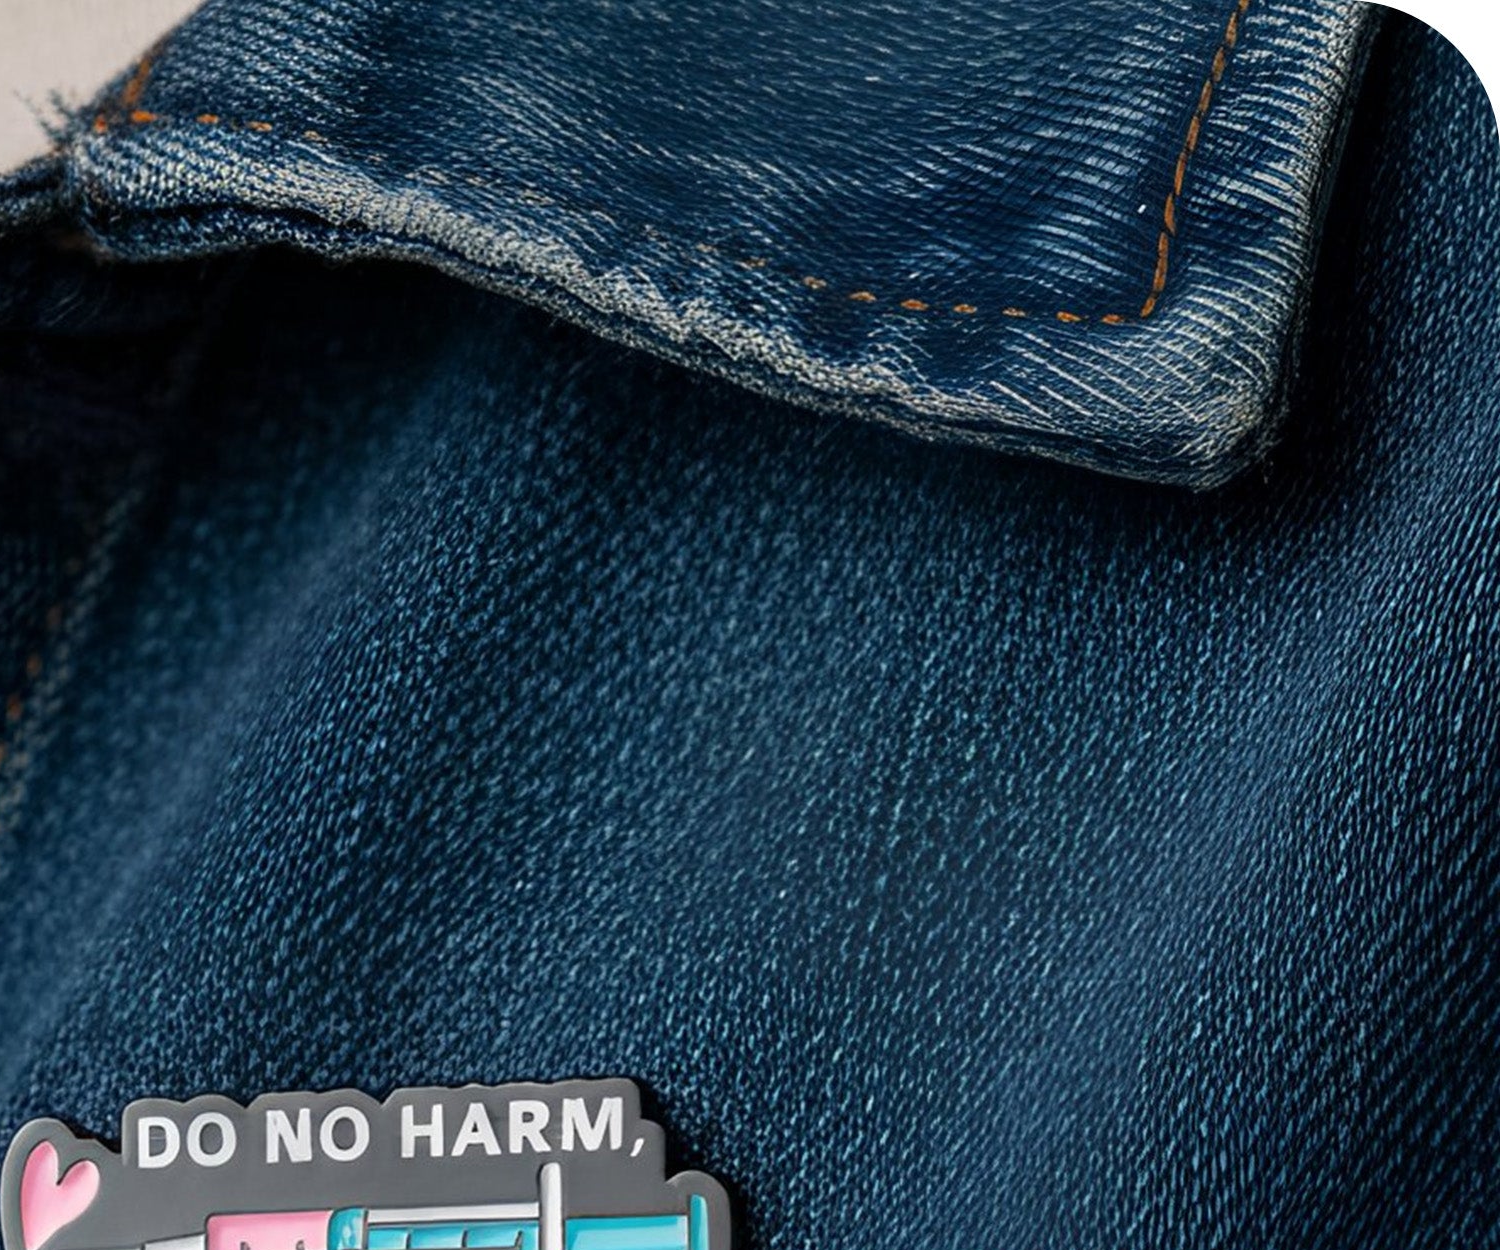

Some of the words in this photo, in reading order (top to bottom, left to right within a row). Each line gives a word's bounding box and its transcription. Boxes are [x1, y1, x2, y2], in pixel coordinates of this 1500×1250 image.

[137, 1112, 238, 1169] DO
[265, 1106, 371, 1164] NO
[400, 1096, 646, 1158] HARM,
